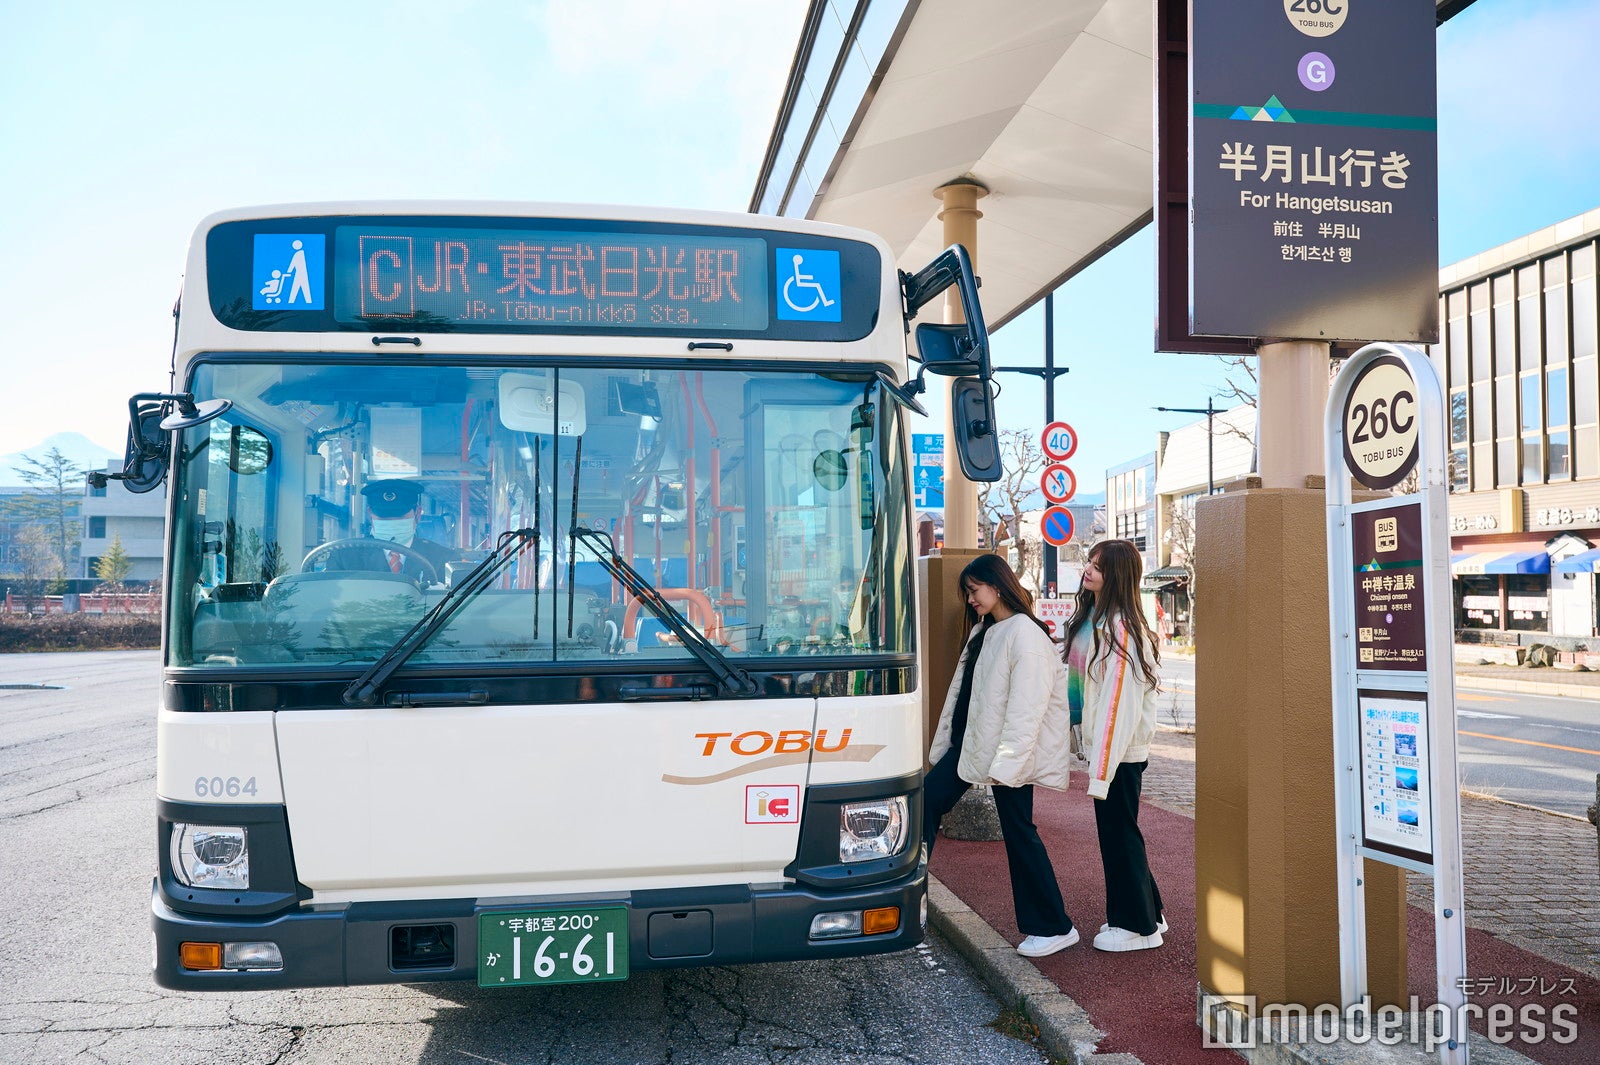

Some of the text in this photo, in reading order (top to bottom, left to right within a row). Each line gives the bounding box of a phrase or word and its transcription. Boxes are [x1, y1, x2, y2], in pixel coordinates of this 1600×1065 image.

[1306, 60, 1326, 83] G
[1219, 142, 1411, 189] 半月山行き
[1240, 190, 1393, 215] For Hangetsusan
[1273, 220, 1361, 240] 前住 半月山
[1280, 245, 1352, 263] 한게츠산 행
[369, 249, 401, 301] C
[650, 304, 698, 323] Sta.
[1351, 390, 1415, 444] 26C
[1050, 433, 1070, 451] 40
[1363, 446, 1404, 463] TOBU BUS
[1378, 521, 1393, 532] BUS
[1362, 573, 1415, 593] 中禅寺温泉
[695, 728, 852, 756] TOBU
[194, 776, 258, 797] 6064
[508, 914, 593, 933] 宇都宮200
[486, 932, 614, 979] か 16-61
